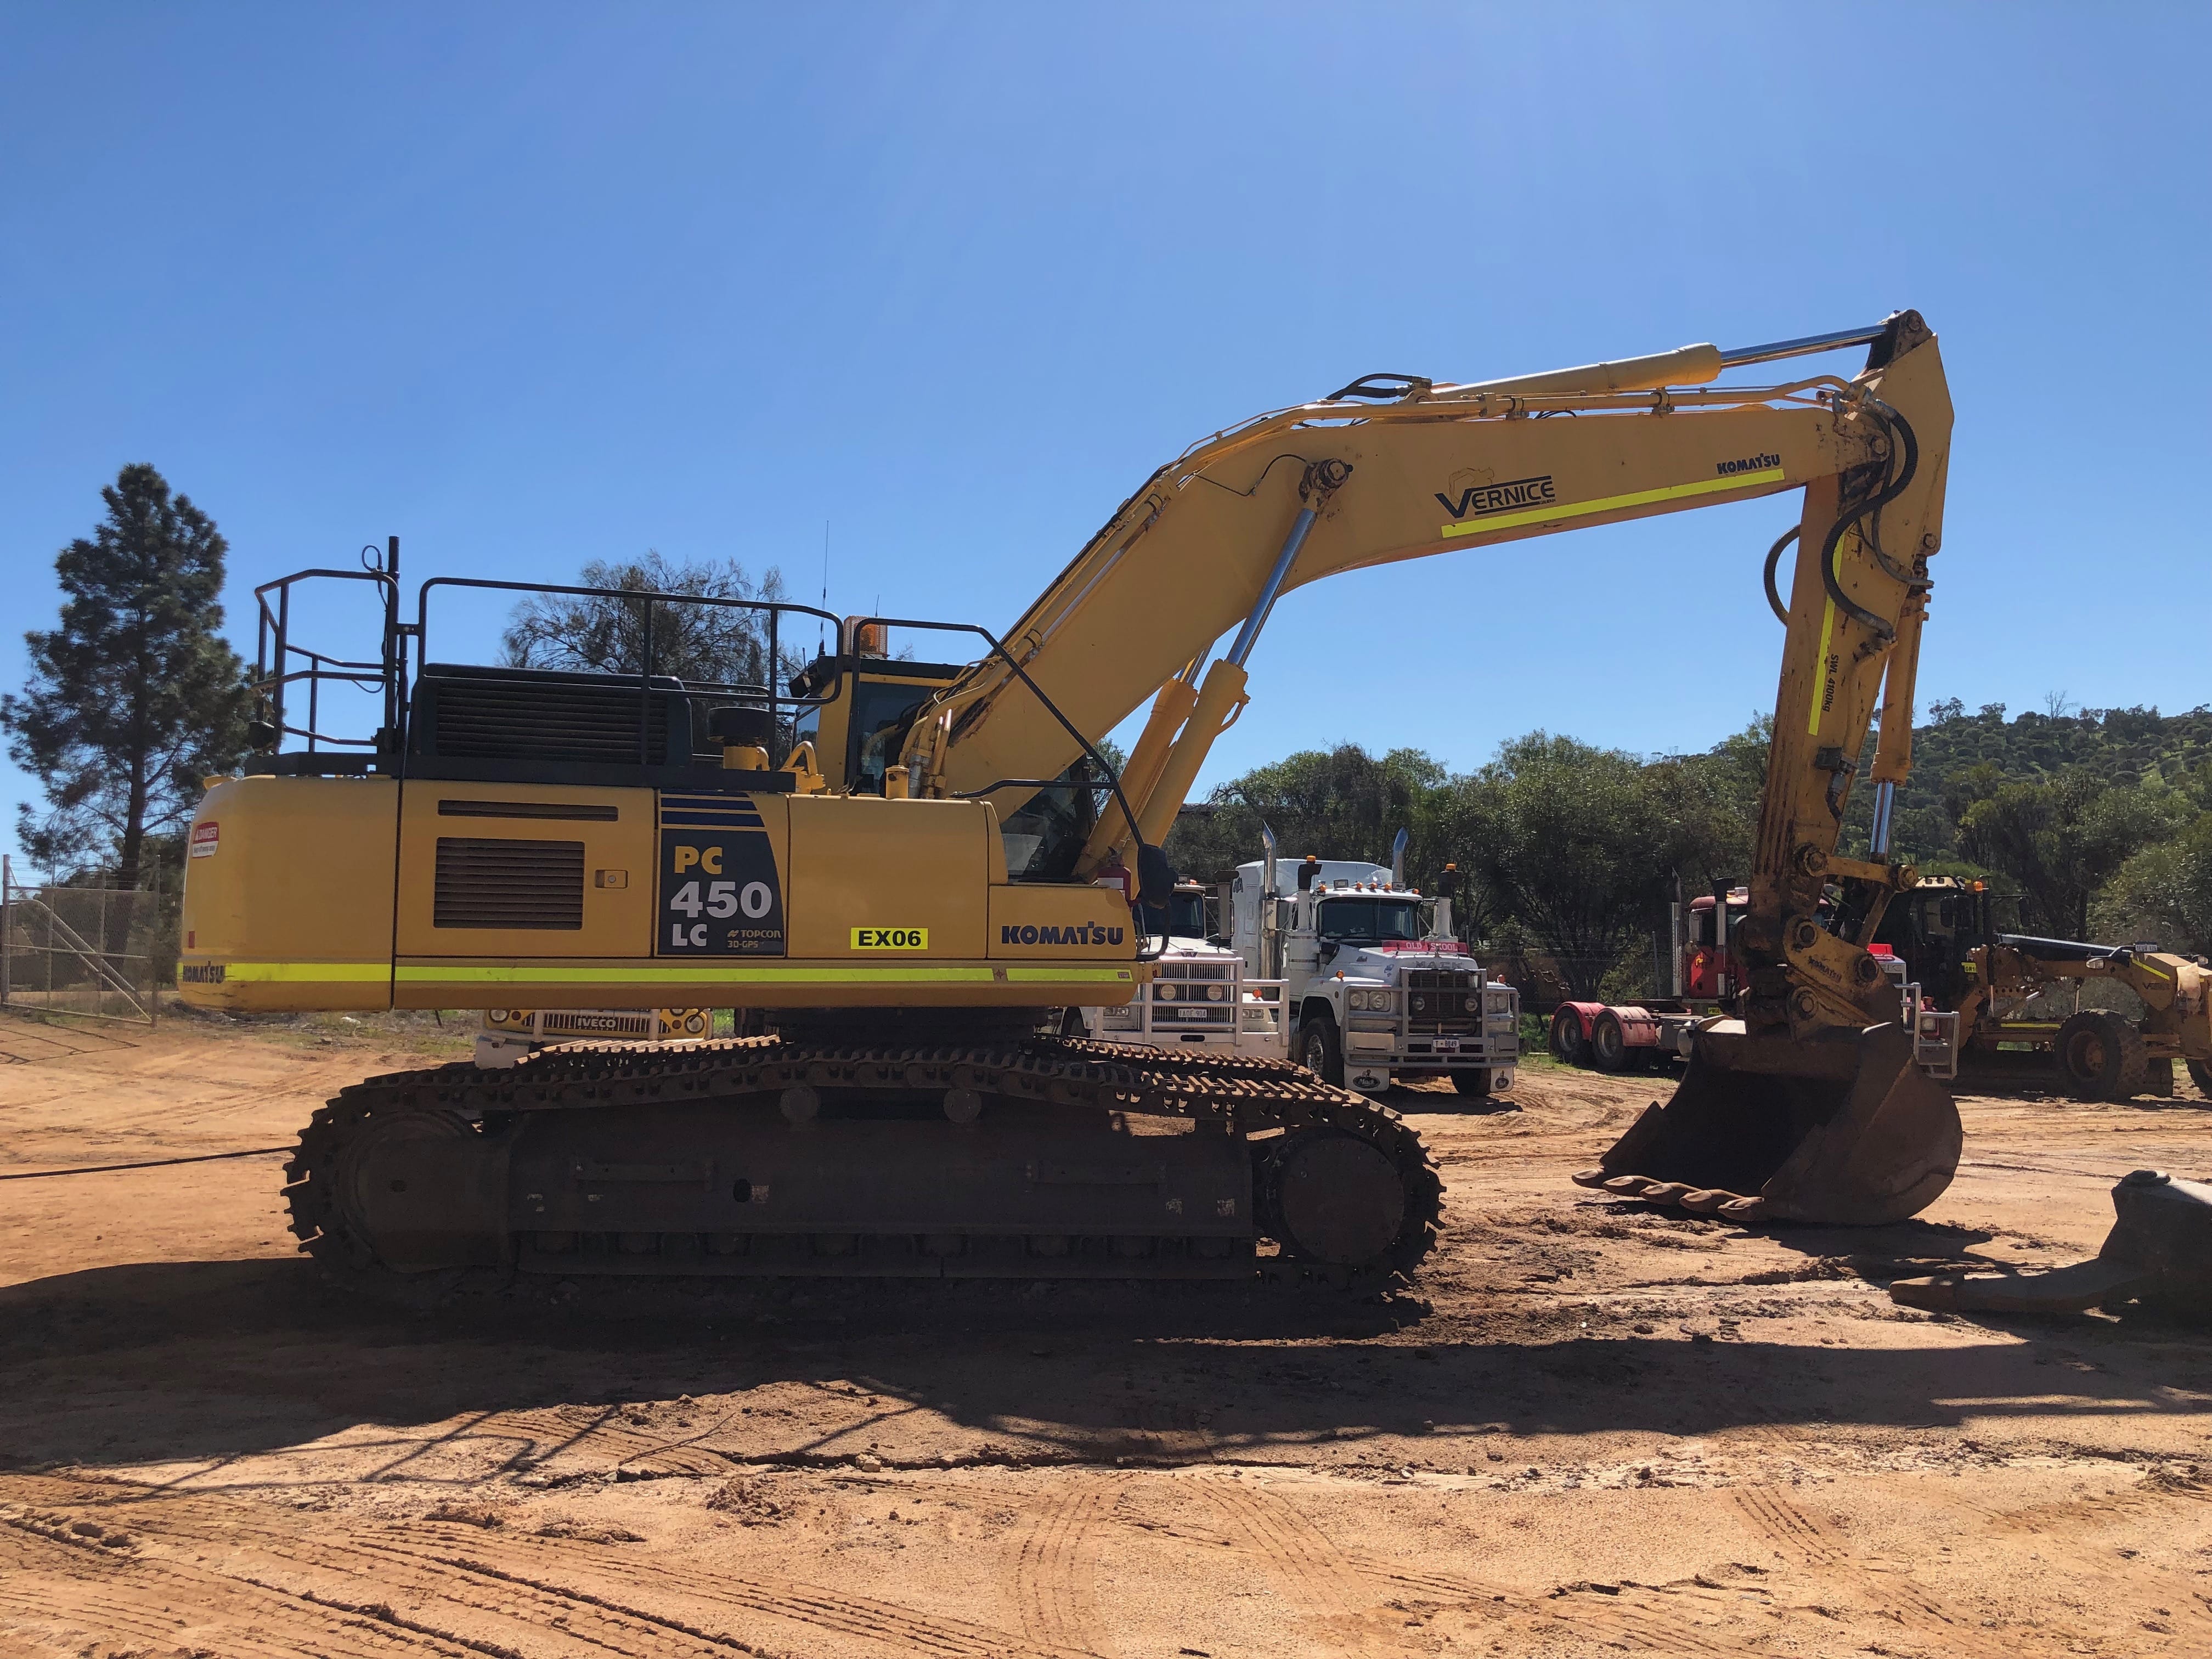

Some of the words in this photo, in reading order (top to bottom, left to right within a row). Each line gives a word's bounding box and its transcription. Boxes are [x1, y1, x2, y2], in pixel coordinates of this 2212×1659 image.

[1717, 453, 1780, 475] KOMATSU
[1434, 476, 1555, 518] VERNICE
[1829, 653, 1838, 674] SWL
[1822, 678, 1835, 712] 4100kg
[674, 845, 723, 874] PC
[670, 881, 772, 918] 450
[672, 923, 707, 946] LC
[741, 929, 782, 938] TOPCON
[858, 930, 922, 946] EX06
[1002, 921, 1124, 945] KOMATSU
[183, 961, 225, 984] KOMATSU
[1414, 960, 1463, 969] MACK
[578, 1018, 617, 1028] IVECO
